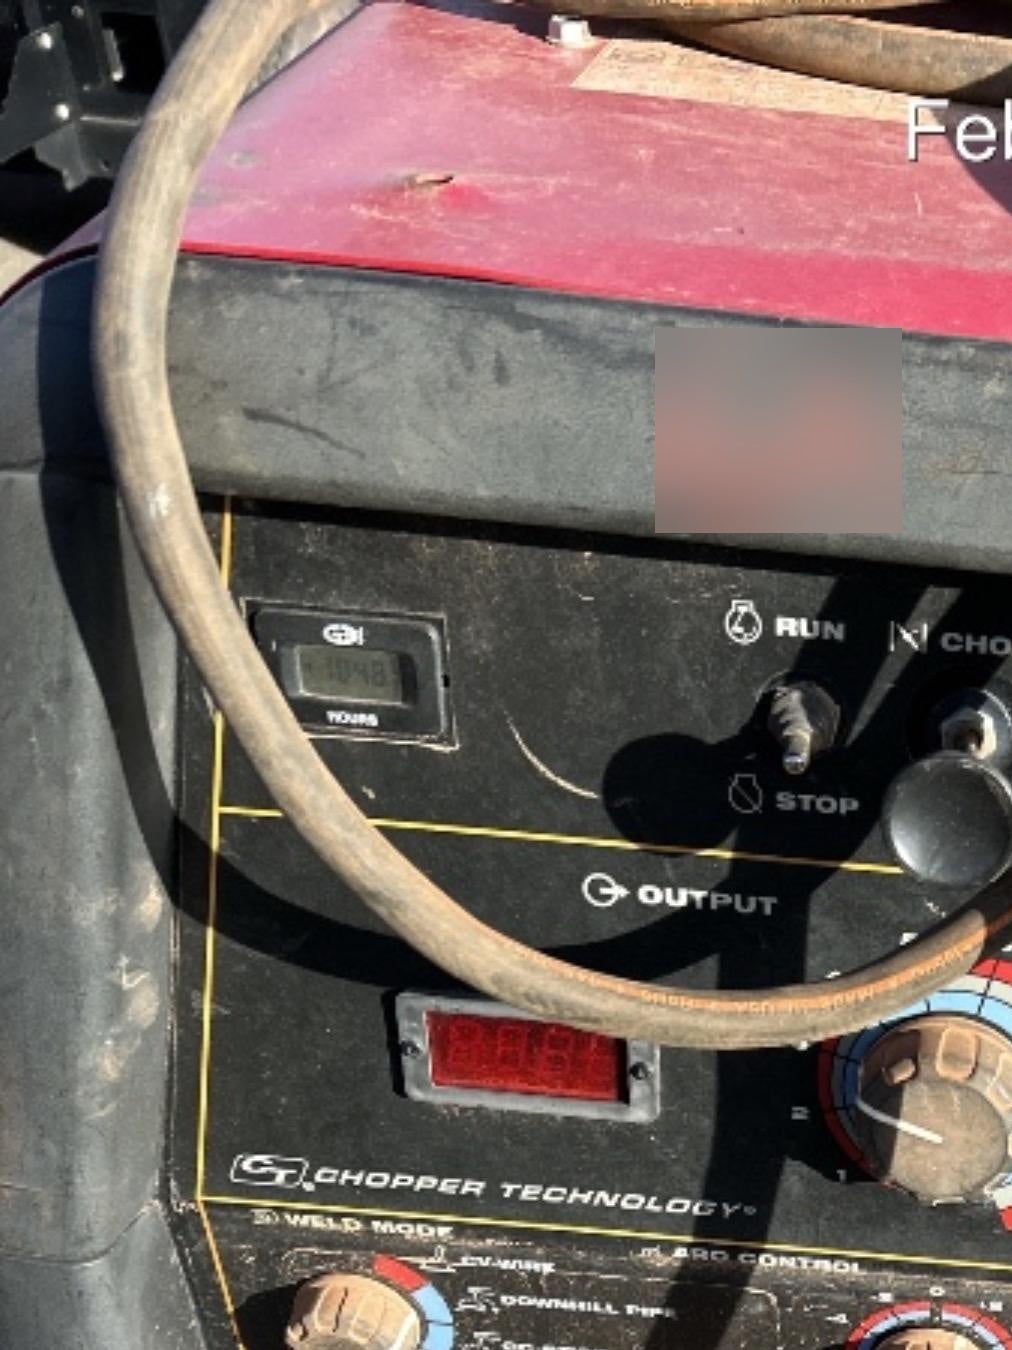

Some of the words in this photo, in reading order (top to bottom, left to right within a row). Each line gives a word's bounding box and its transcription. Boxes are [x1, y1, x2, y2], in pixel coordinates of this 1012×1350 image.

[775, 615, 844, 641] RUN
[775, 791, 860, 815] STOP
[637, 884, 778, 916] OUTPUT
[313, 1166, 487, 1197] CHOPPER
[283, 1212, 363, 1233] WELD
[370, 1219, 454, 1239] MODE
[738, 1252, 866, 1274] CONTROL
[501, 1294, 619, 1315] DOWNHILL
